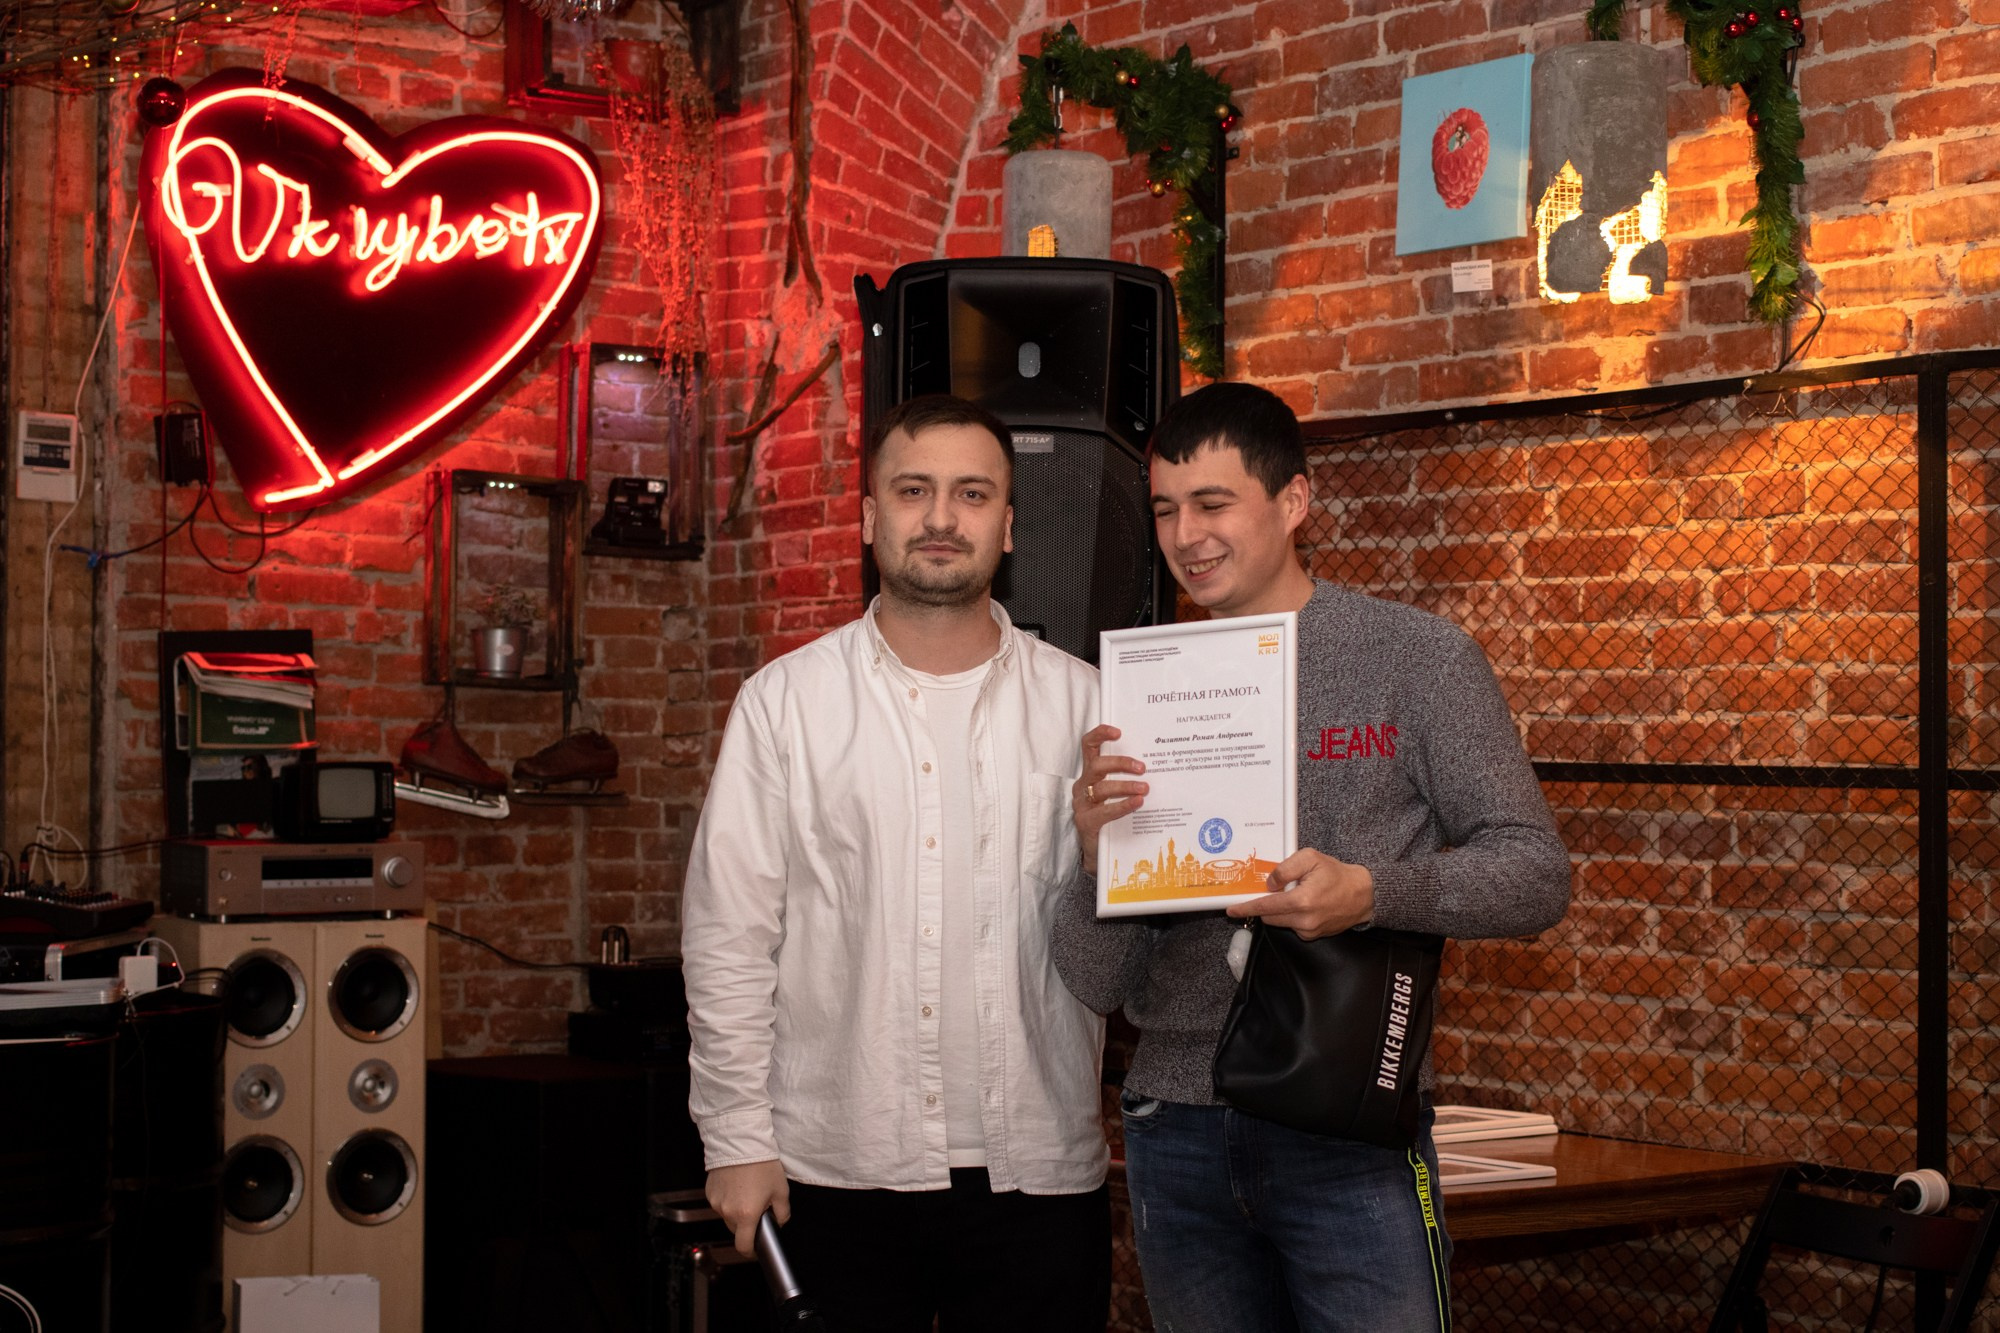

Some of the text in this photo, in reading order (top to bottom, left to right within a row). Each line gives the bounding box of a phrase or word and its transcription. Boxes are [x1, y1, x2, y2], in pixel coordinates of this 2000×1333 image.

[1013, 436, 1024, 444] RT
[1259, 633, 1279, 642] МОЛ
[1259, 647, 1279, 656] KRD
[1147, 686, 1261, 704] ПОЧЁТНАЯ ГРАМОТА
[1176, 713, 1231, 723] НАГРАЖДАЕТСЯ
[1154, 731, 1253, 744] Филиппов Роман Андреевич
[1307, 723, 1399, 760] JEANS
[1240, 759, 1271, 767] Краснодар
[1376, 972, 1413, 1090] BIKKEMBERGS
[1416, 1162, 1435, 1228] BIKKEMBERGS
